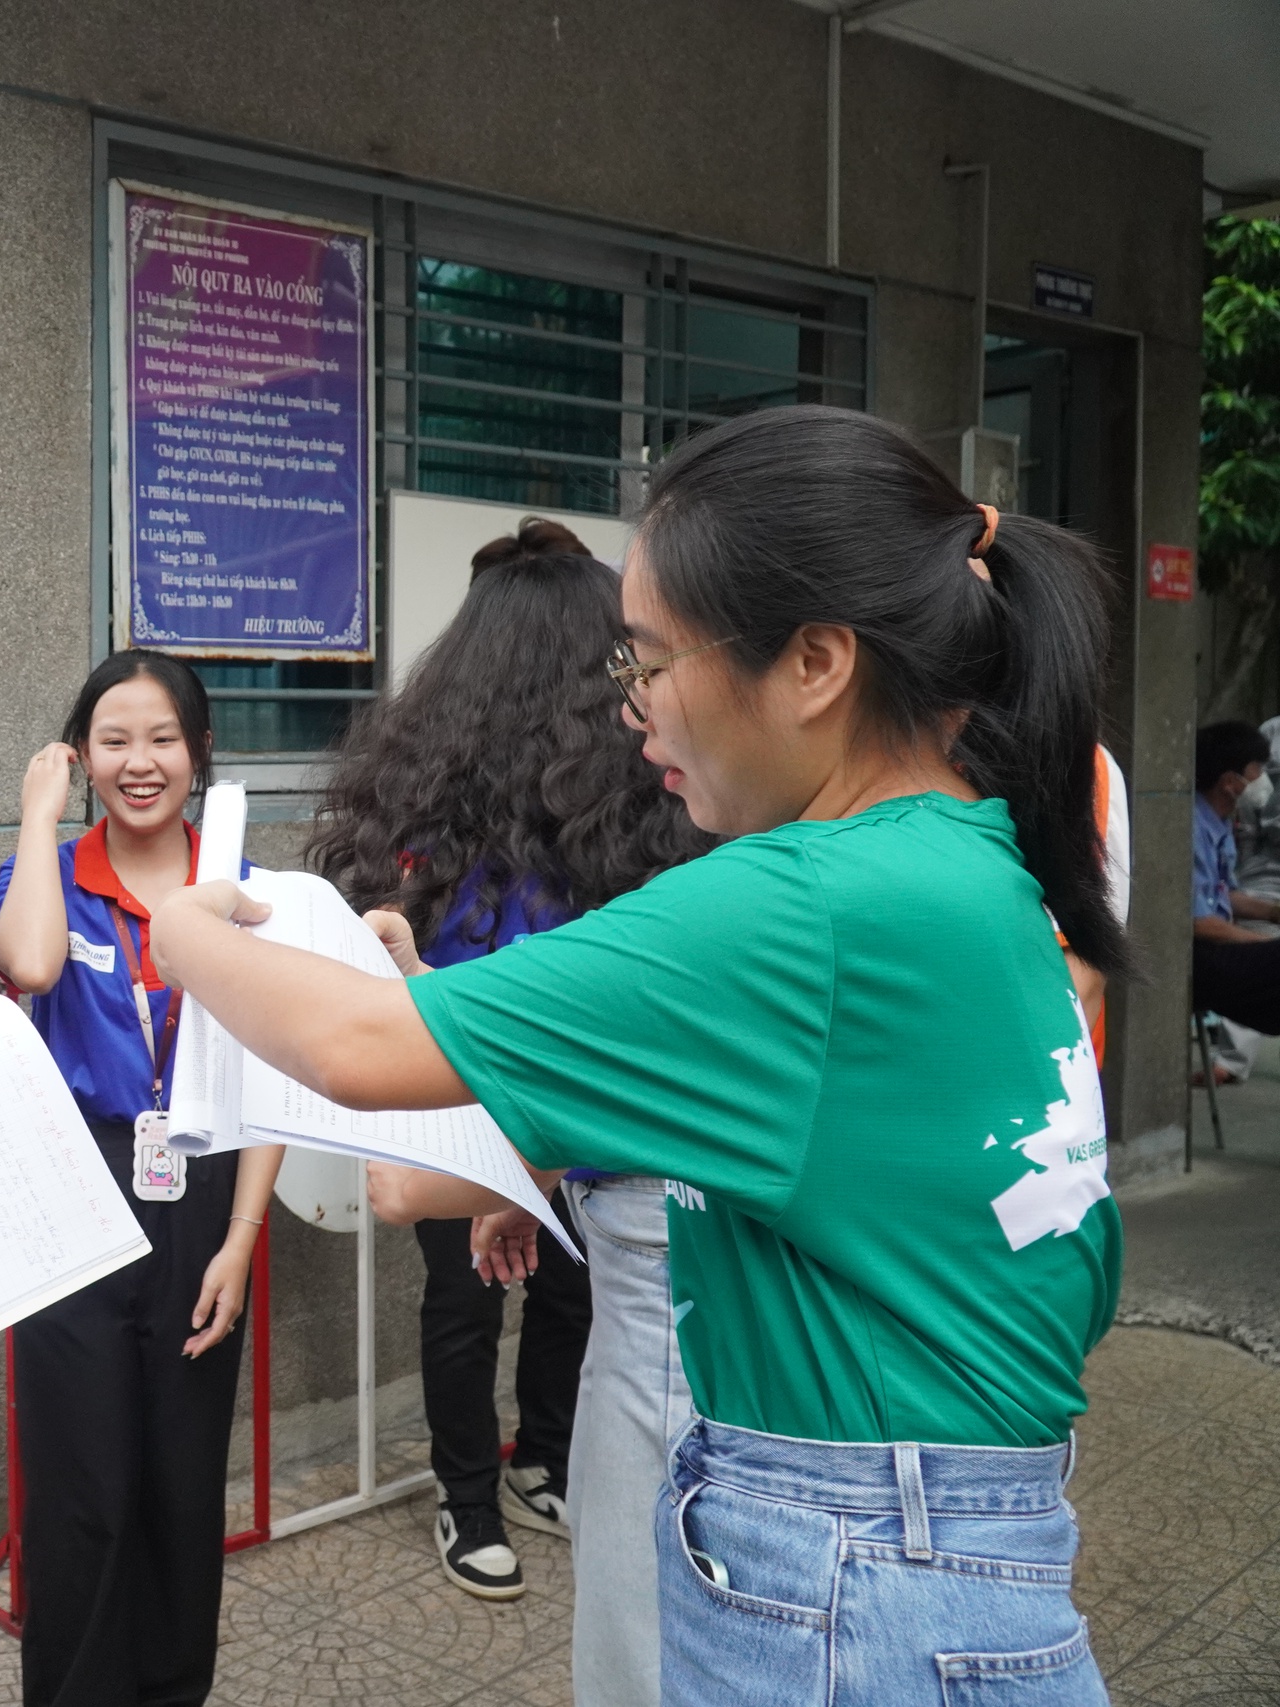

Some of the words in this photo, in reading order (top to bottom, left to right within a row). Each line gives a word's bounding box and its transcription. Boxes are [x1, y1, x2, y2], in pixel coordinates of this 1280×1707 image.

[172, 260, 198, 291] NỘI
[201, 269, 230, 294] QUY
[234, 274, 252, 296] RA
[255, 273, 284, 300] VÀO
[286, 275, 323, 306] CỔNG
[244, 615, 274, 635] HIỆU
[90, 952, 110, 962] LONG
[1066, 1144, 1088, 1164] VAS
